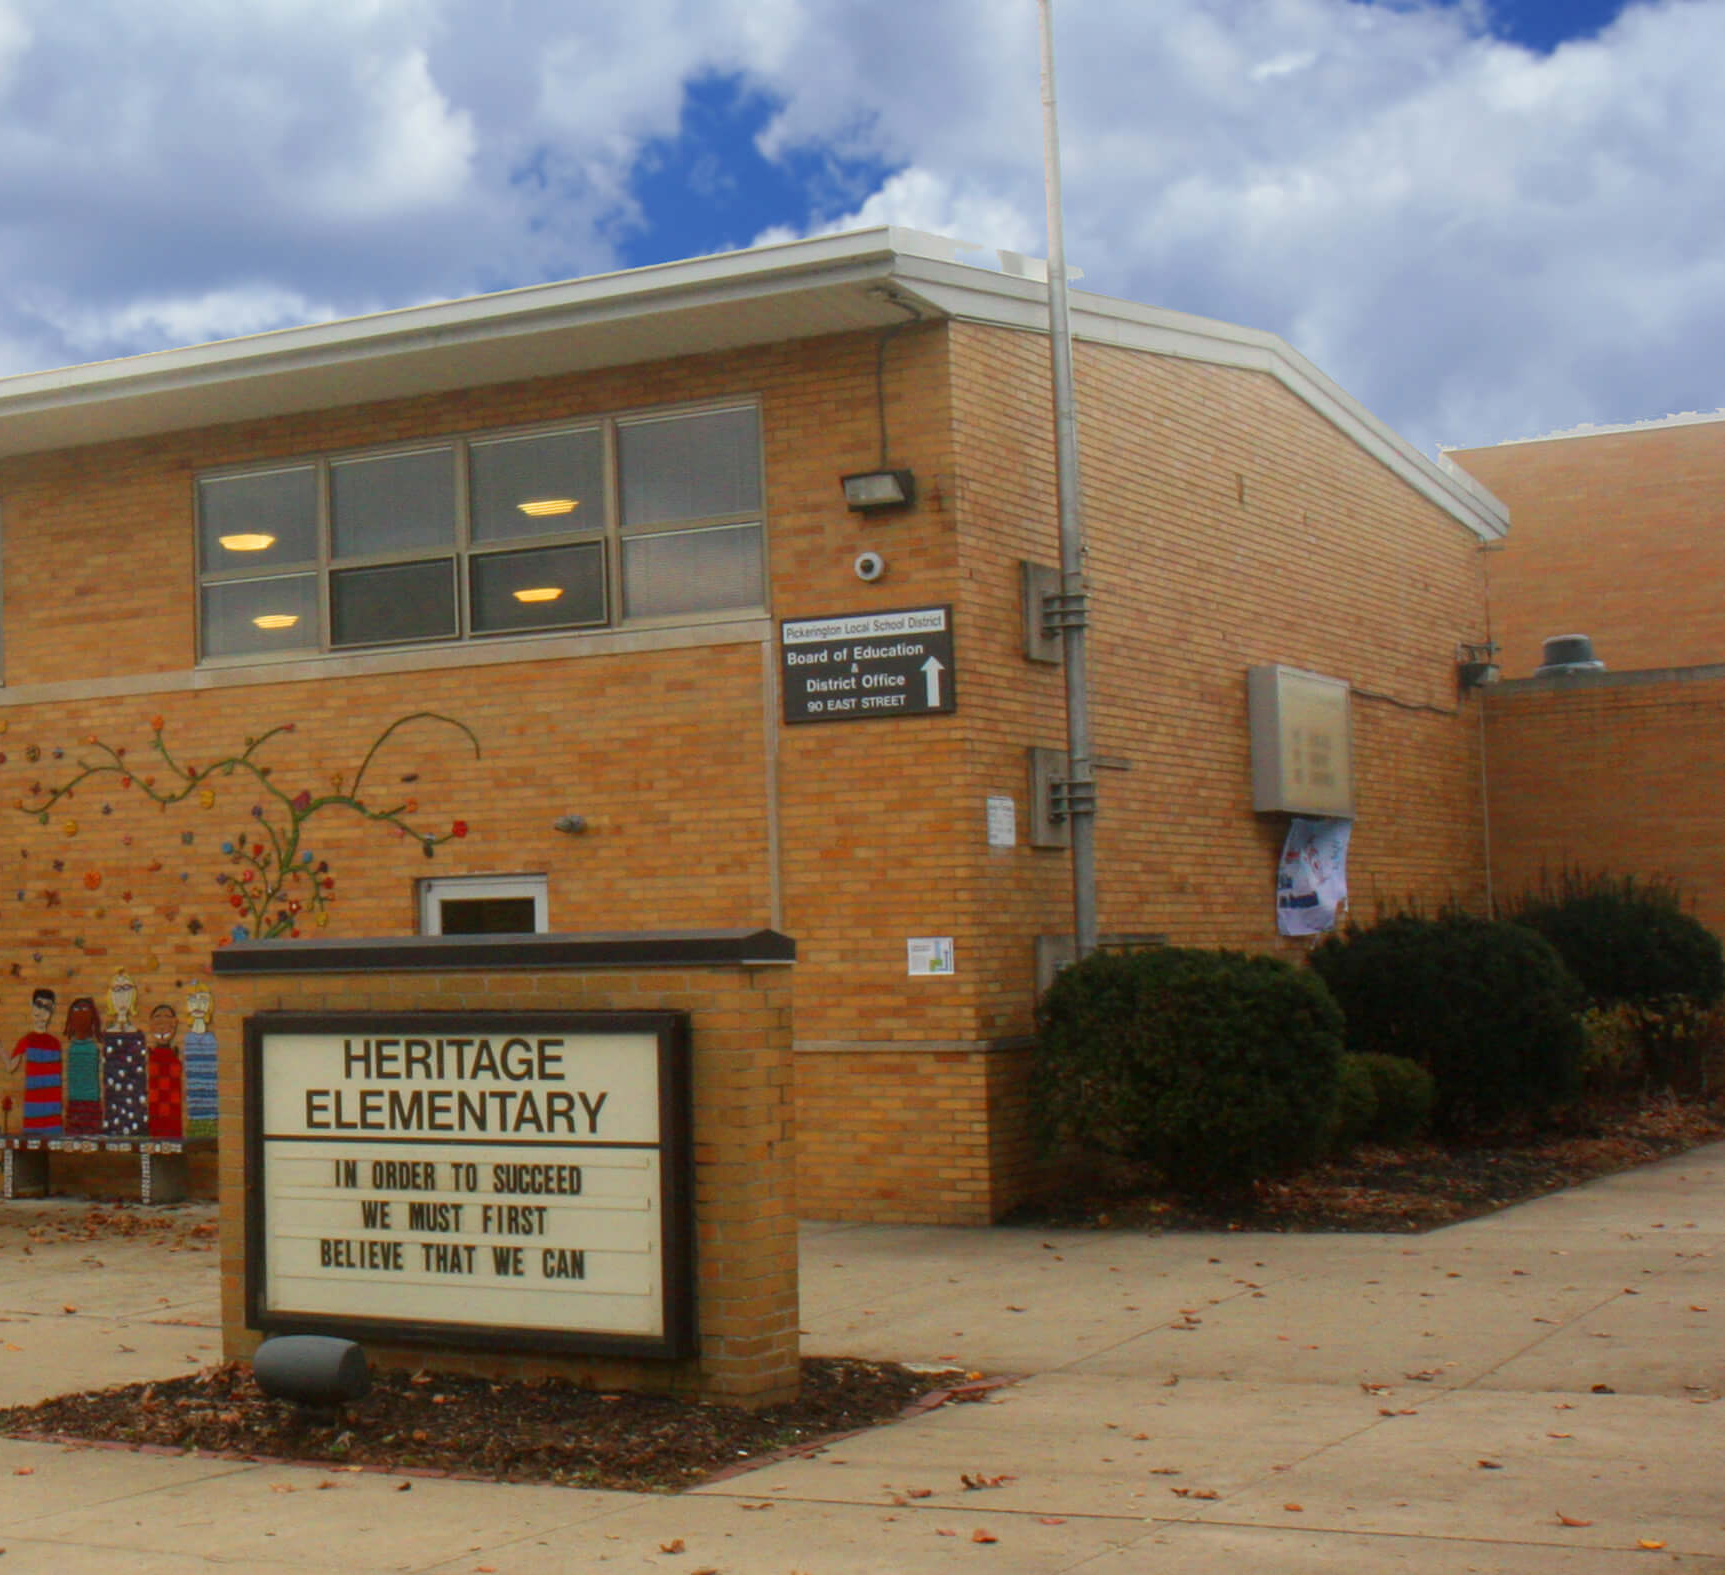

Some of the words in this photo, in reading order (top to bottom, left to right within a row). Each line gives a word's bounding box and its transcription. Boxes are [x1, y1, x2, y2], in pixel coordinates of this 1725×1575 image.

[786, 625, 842, 639] Pickerington
[845, 623, 870, 635] Local
[873, 618, 905, 632] School
[907, 615, 942, 629] District
[787, 650, 828, 665] Board
[833, 648, 848, 661] of
[853, 643, 924, 660] Education
[806, 676, 856, 693] District
[861, 673, 906, 689] Office
[807, 700, 823, 712] 90
[827, 698, 856, 711] EAST
[861, 694, 906, 709] STREET
[343, 1038, 566, 1081] HERITAGE
[305, 1089, 608, 1134] ELEMENTARY
[334, 1159, 358, 1188] IN
[371, 1160, 436, 1191] ORDER
[450, 1163, 477, 1192] TO
[493, 1164, 583, 1196] SUCCEED
[361, 1200, 391, 1230] WE
[408, 1202, 463, 1232] MUST
[481, 1205, 548, 1235] FIRST
[320, 1239, 404, 1271] BELIEVE
[421, 1243, 476, 1274] THAT
[492, 1246, 525, 1277] WE
[541, 1248, 586, 1280] CAN
